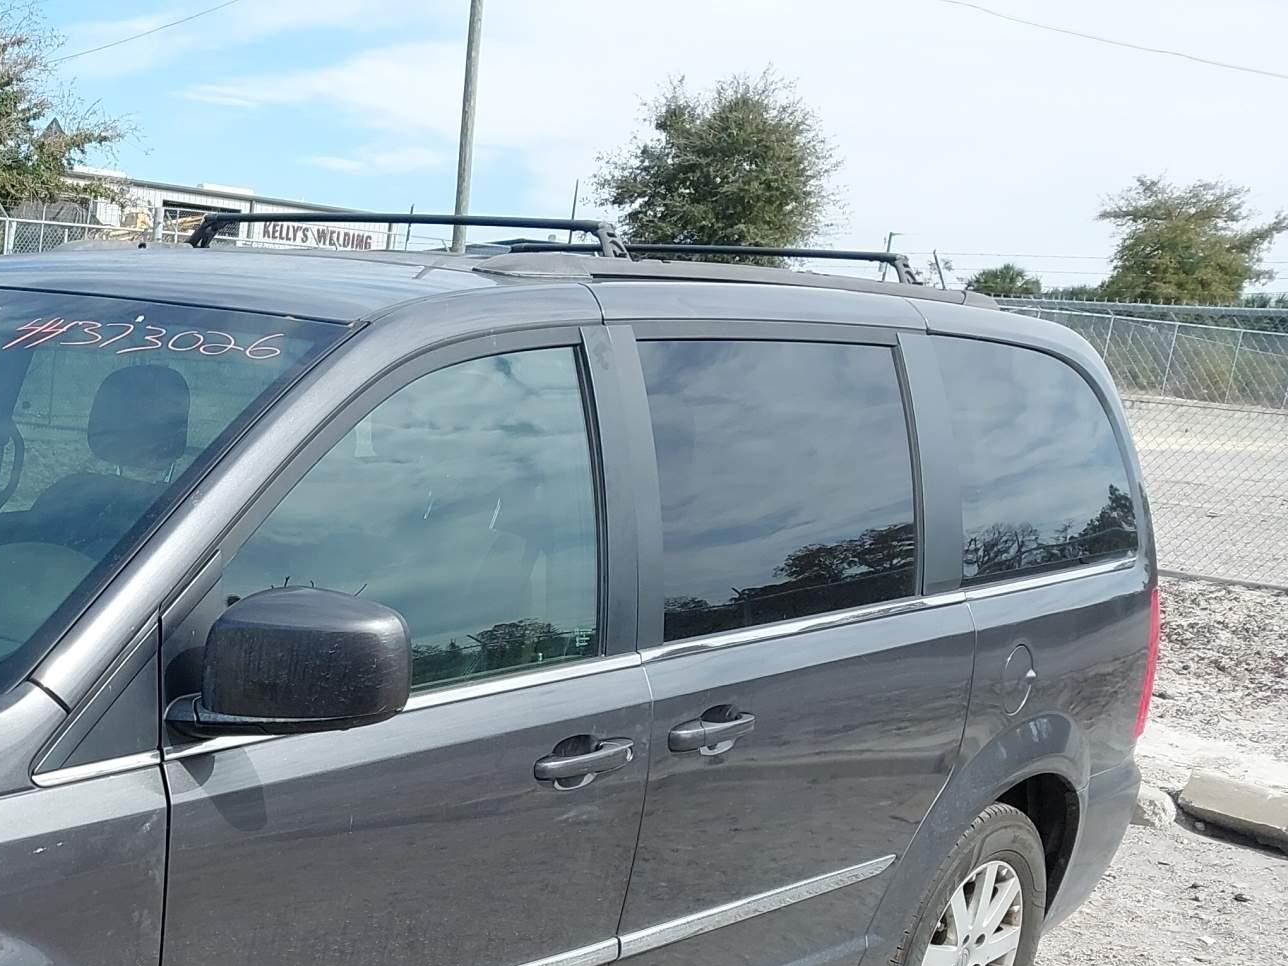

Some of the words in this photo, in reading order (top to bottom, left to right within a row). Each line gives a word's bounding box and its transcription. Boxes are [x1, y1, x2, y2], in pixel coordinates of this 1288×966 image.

[262, 220, 310, 244] KELLY'S
[316, 227, 373, 250] WELDING
[2, 317, 286, 359] 44373026
